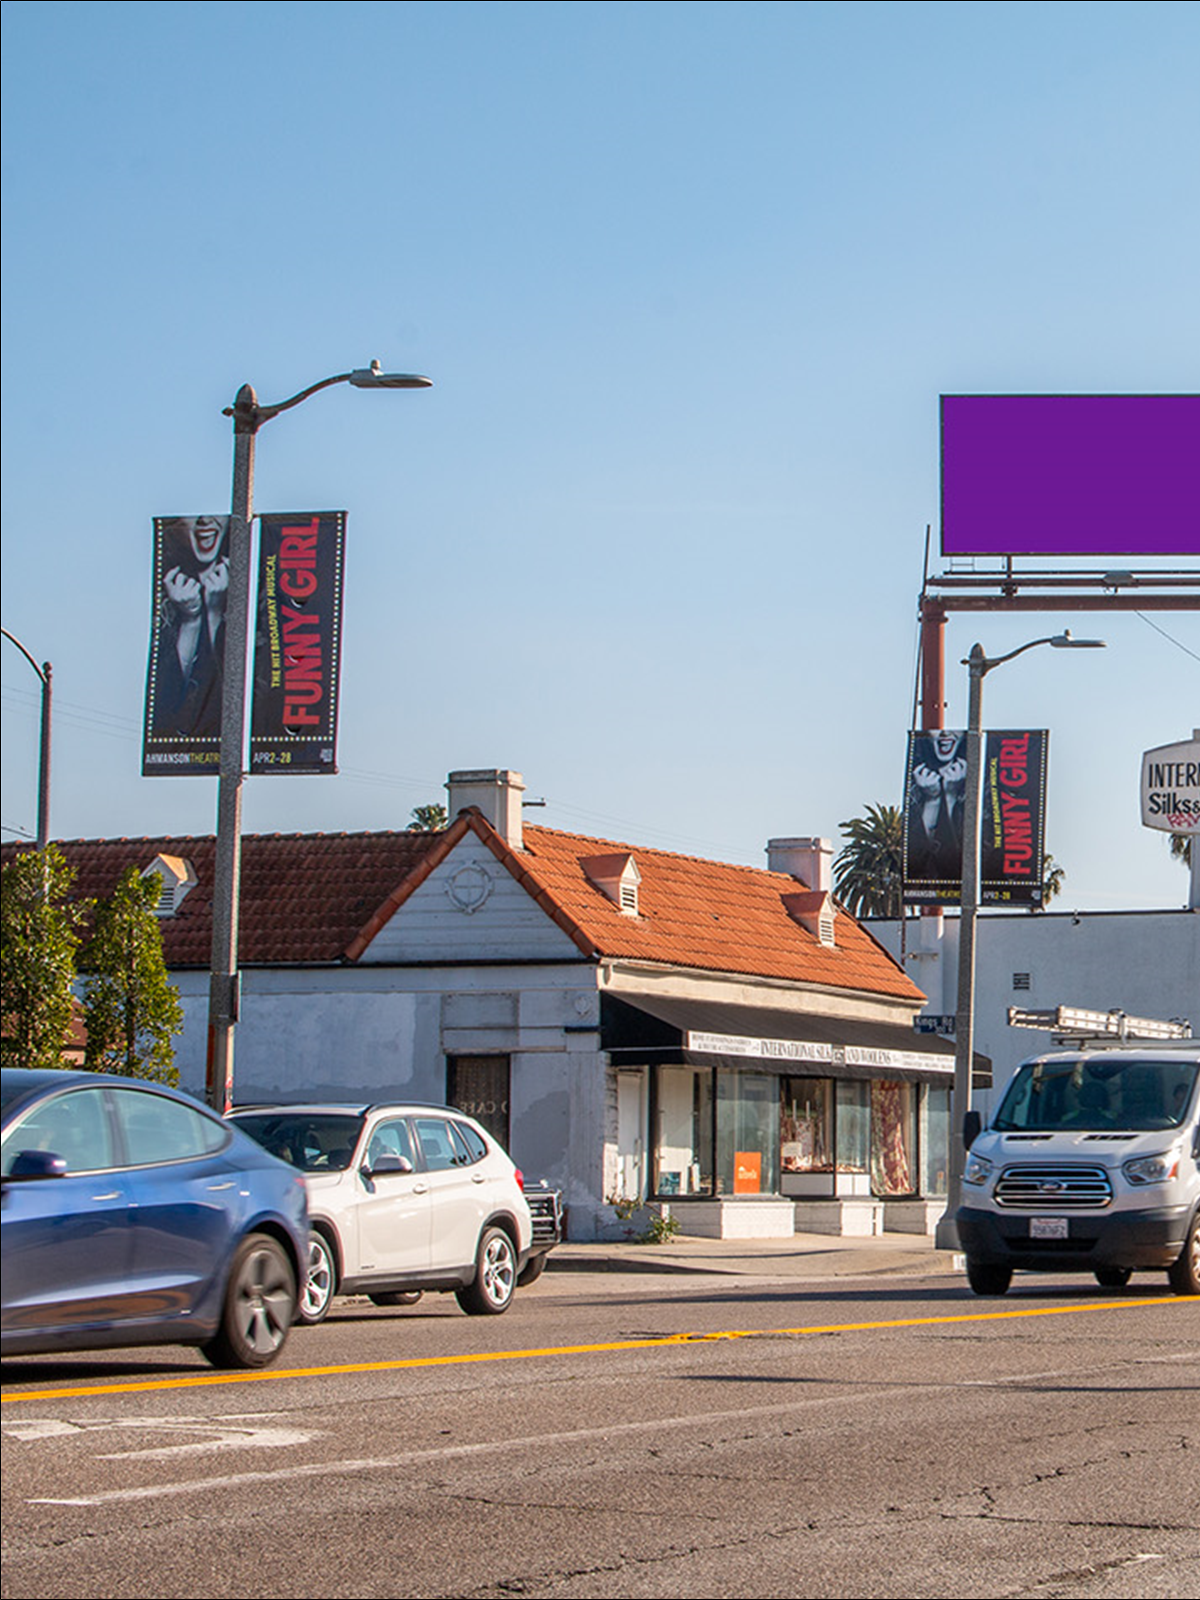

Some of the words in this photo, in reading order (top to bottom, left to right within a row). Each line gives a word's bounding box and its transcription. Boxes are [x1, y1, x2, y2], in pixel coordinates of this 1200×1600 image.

[265, 554, 277, 597] MUSICAL
[279, 517, 320, 598] GIRL
[267, 599, 280, 651] BROADWAY
[270, 652, 280, 669] HIT
[271, 671, 281, 688] THE
[281, 605, 323, 725] FUNNY
[999, 732, 1030, 787] GIRL
[1002, 791, 1033, 875] FUNNY
